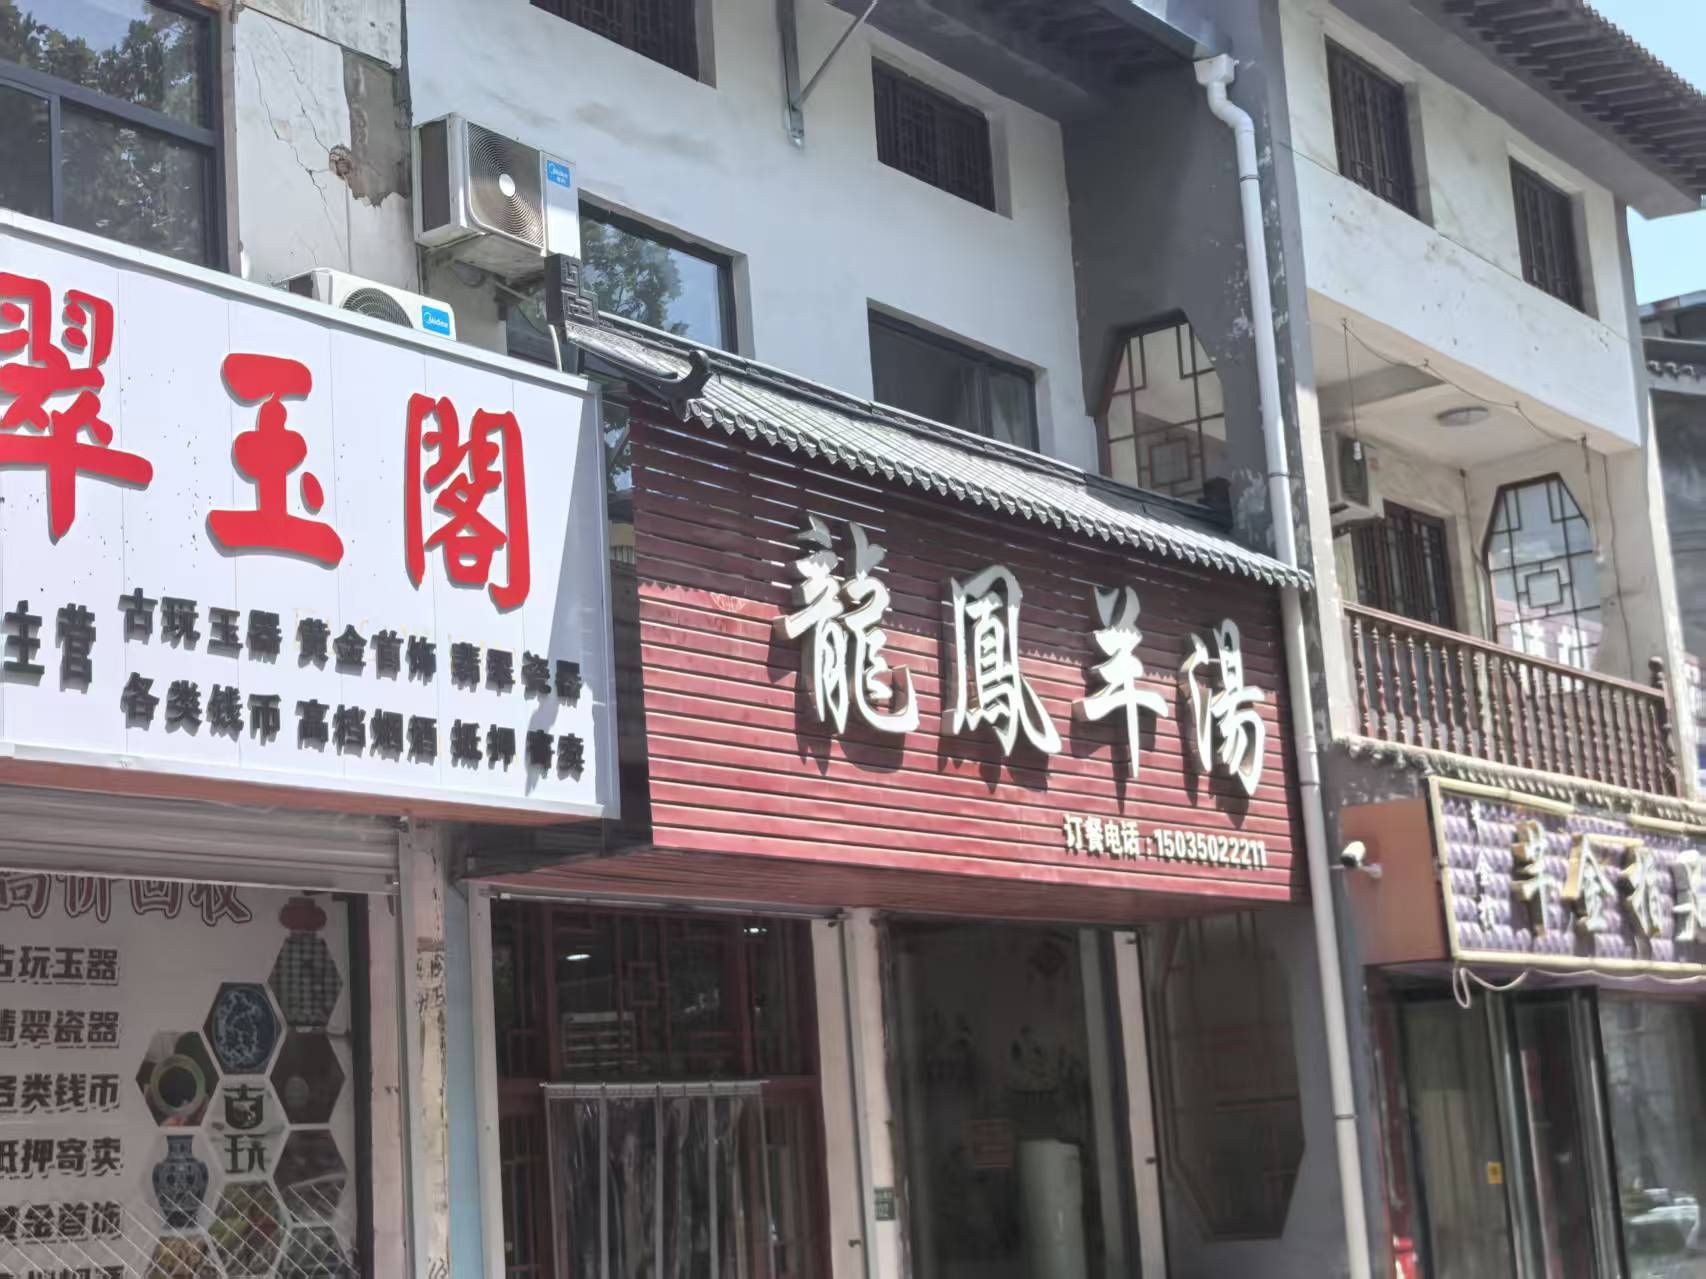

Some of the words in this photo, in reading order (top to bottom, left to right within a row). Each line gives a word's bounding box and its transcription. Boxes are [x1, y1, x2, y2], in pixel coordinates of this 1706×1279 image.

[2, 599, 96, 692] 主营
[119, 588, 281, 662] 古玩玉器
[297, 618, 437, 684] 黄金首饰
[450, 642, 582, 706] 翡翠瓷器
[774, 516, 1266, 797] 龍鳳羊湯
[121, 672, 282, 744] 各类钱币
[296, 699, 438, 765] 高档烟酒
[450, 719, 585, 781] 抵押寄卖
